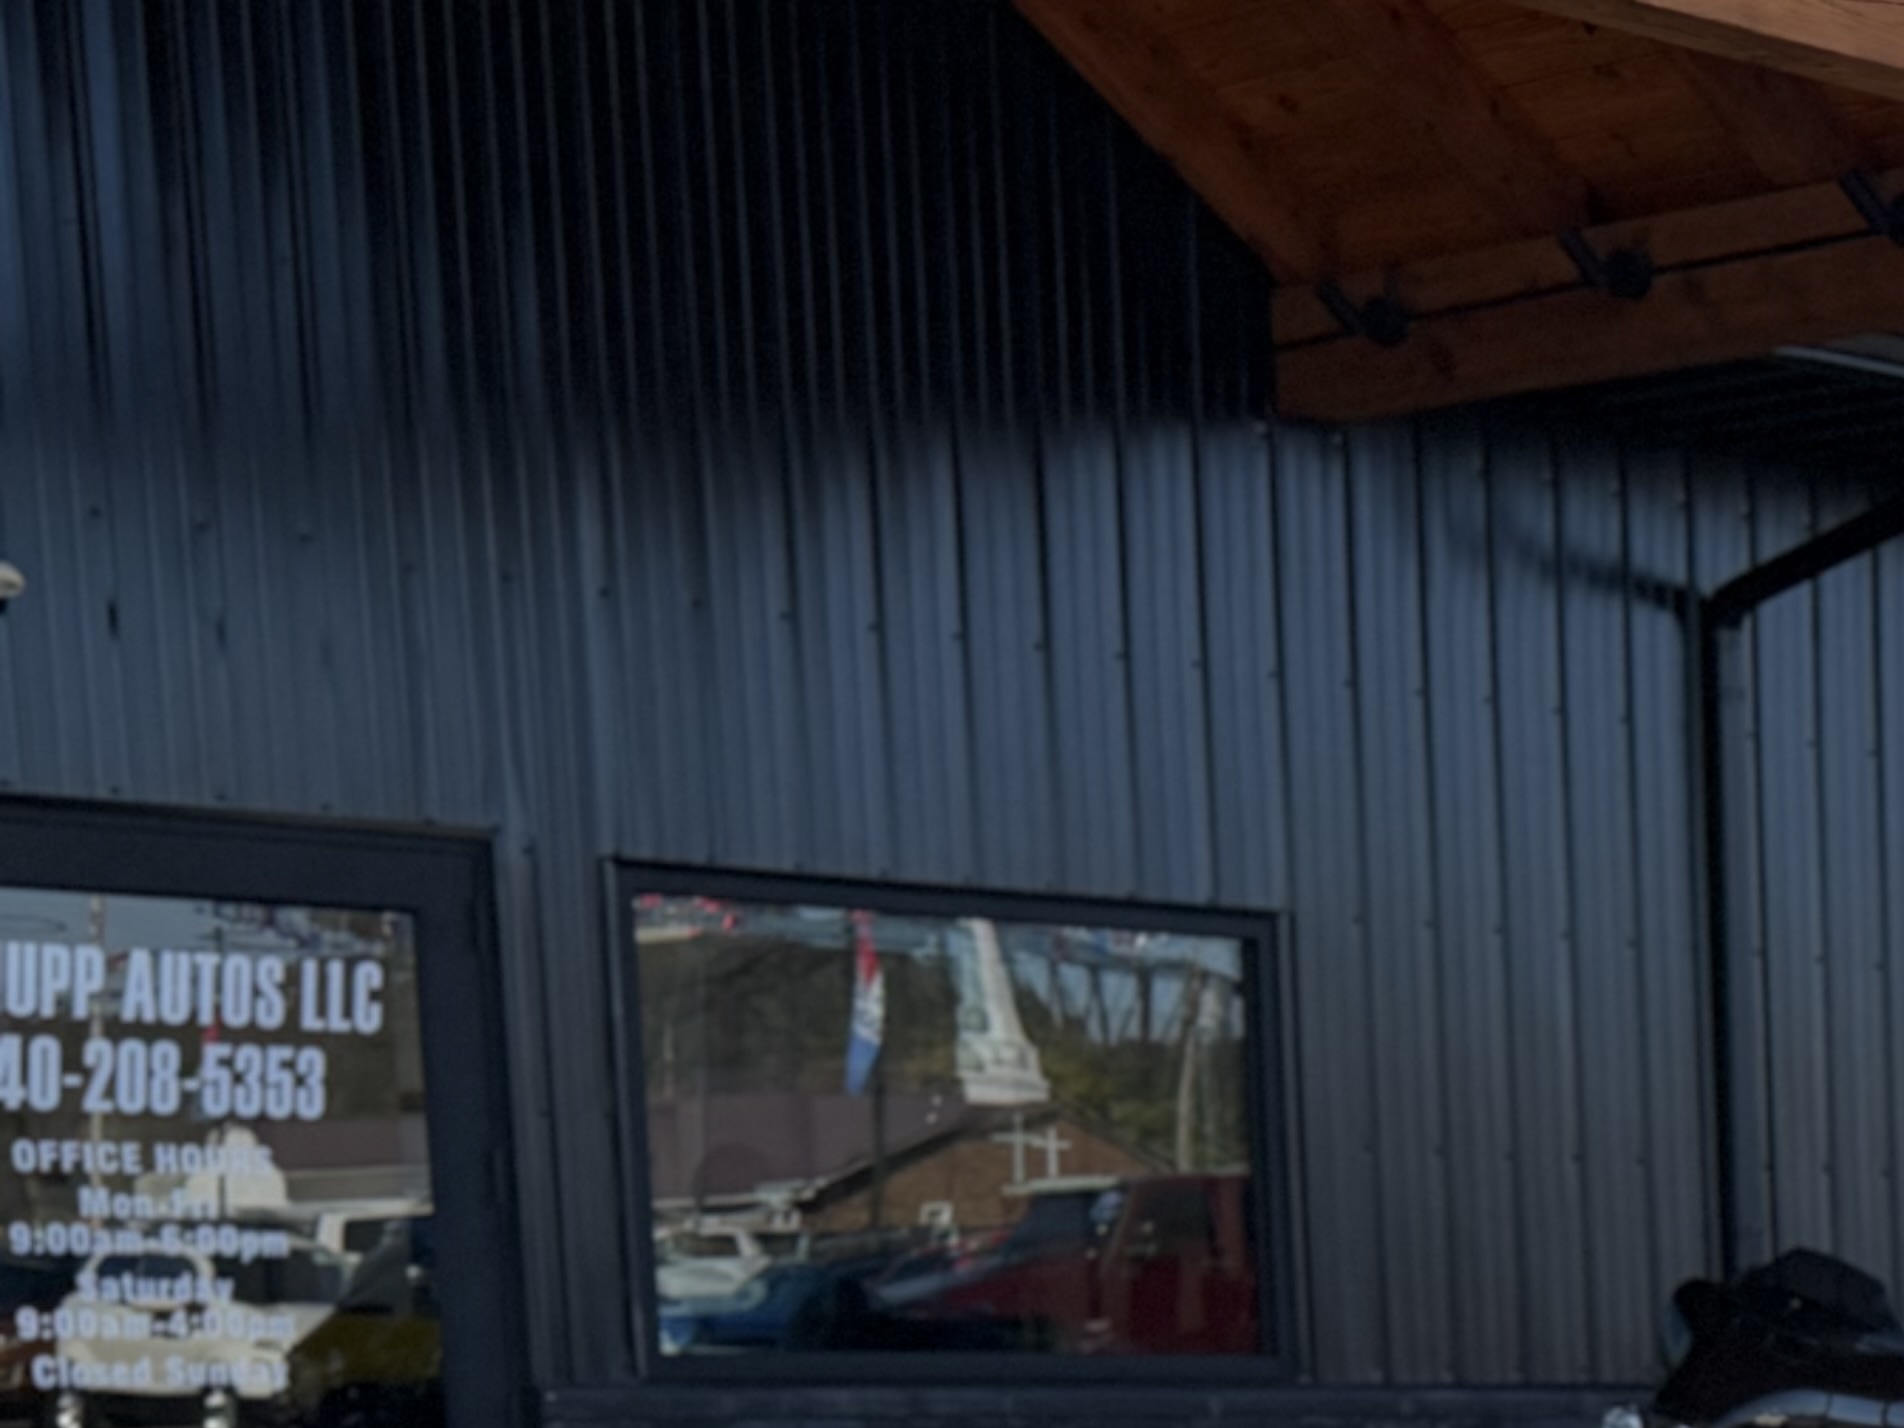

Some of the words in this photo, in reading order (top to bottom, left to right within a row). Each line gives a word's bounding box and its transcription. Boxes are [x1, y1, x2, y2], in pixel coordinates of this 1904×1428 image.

[0, 940, 106, 1020] UPP
[121, 948, 286, 1030] AUTOS
[299, 957, 384, 1035] LLC
[0, 1032, 327, 1120] 40-208-5353
[11, 1139, 142, 1175] OFFICE
[153, 1144, 273, 1176] HOURS
[76, 1271, 234, 1305] Saturday
[31, 1355, 153, 1389] Closed
[165, 1356, 290, 1392] Sunday
